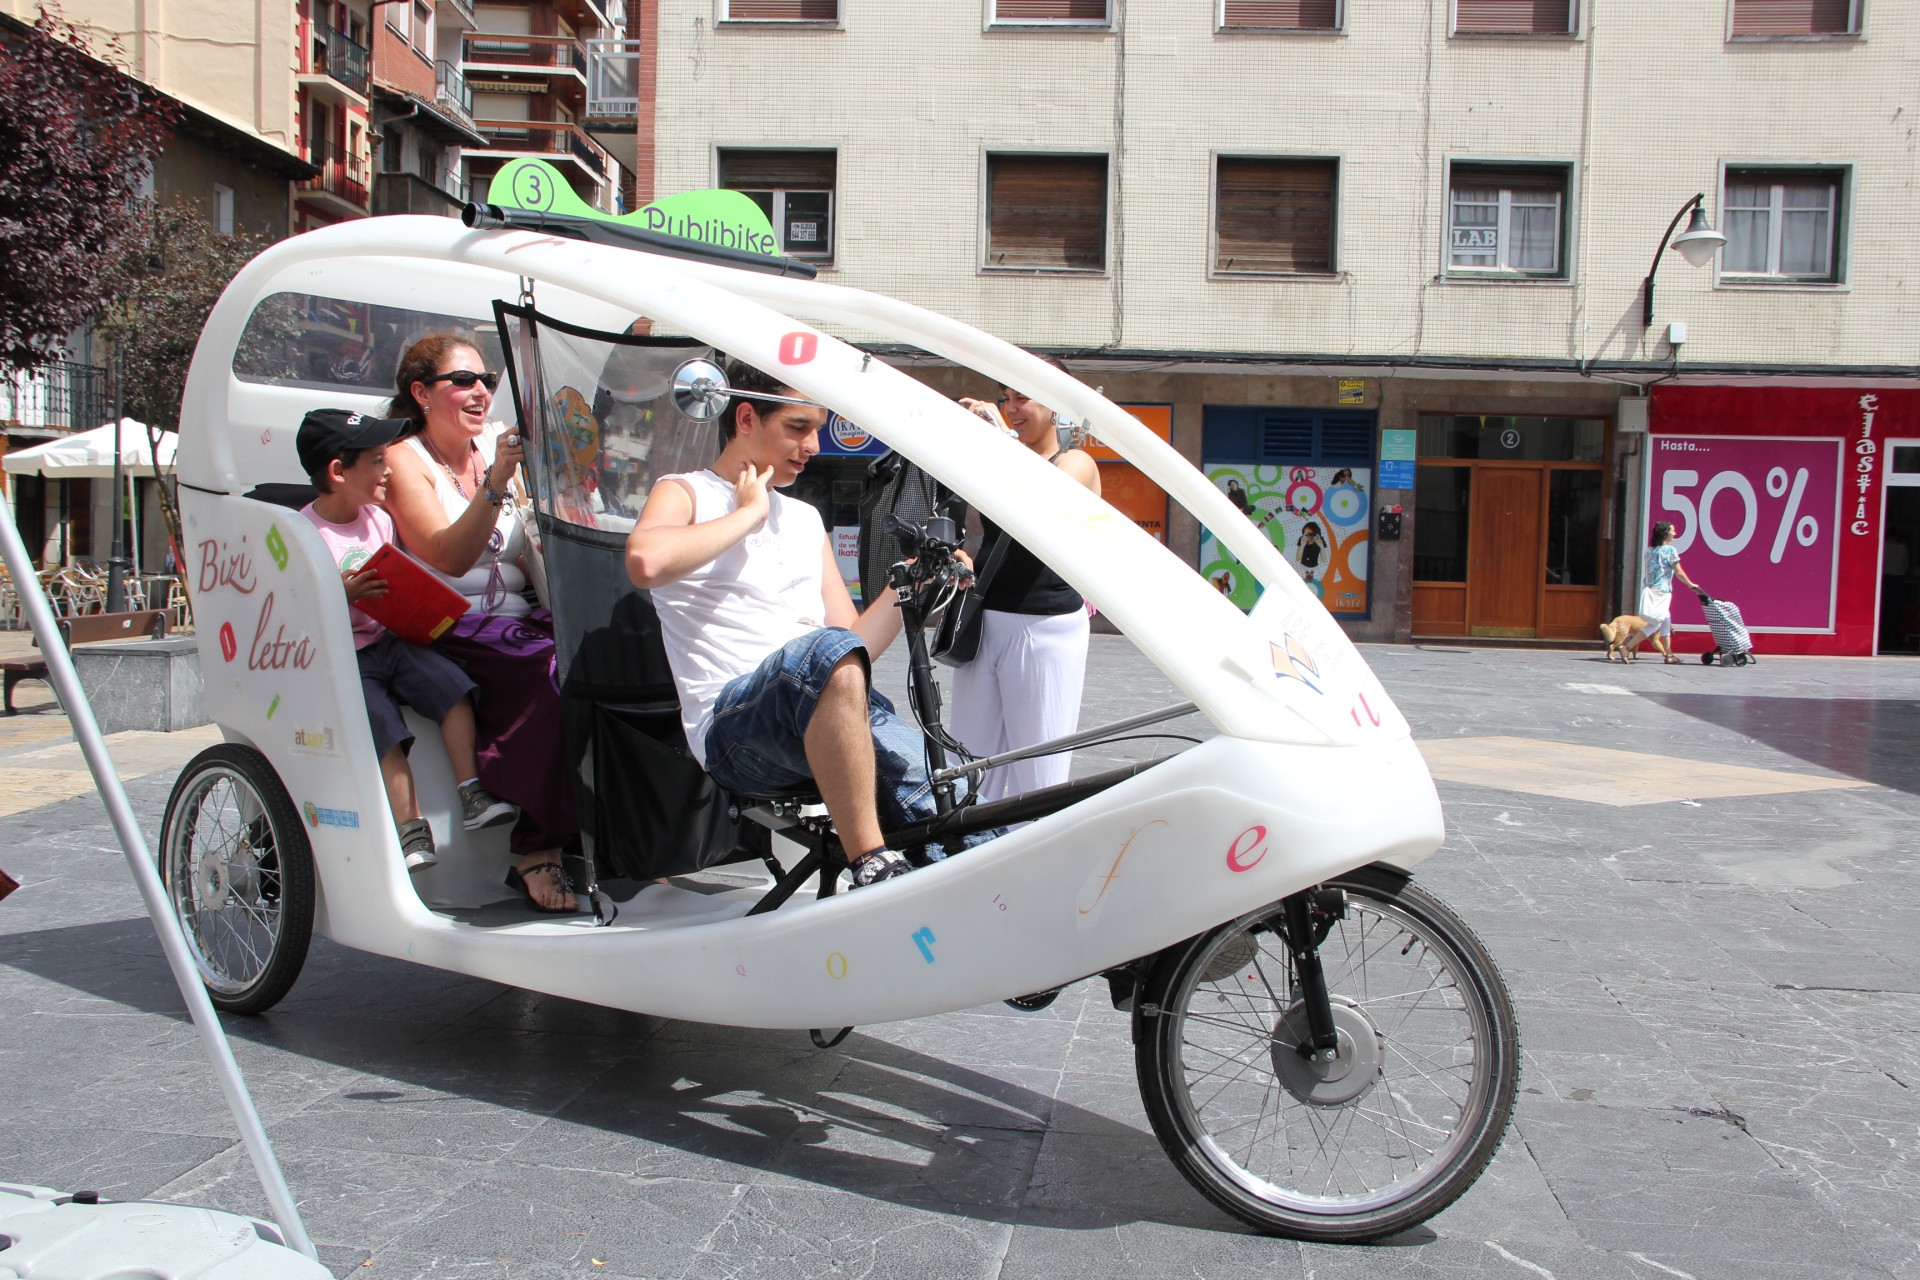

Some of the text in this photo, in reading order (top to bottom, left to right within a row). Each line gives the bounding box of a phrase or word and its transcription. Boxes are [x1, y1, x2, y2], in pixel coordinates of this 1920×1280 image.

[526, 174, 541, 204] 3
[644, 207, 775, 255] Publibike
[1454, 231, 1496, 246] LAB
[1507, 434, 1514, 444] 2
[1851, 393, 1879, 536] elastic
[1133, 520, 1161, 528] ENTA
[1662, 466, 1818, 564] 50%
[198, 535, 257, 594] Bizi
[249, 592, 315, 670] letra
[1226, 825, 1268, 872] e
[911, 926, 936, 964] r
